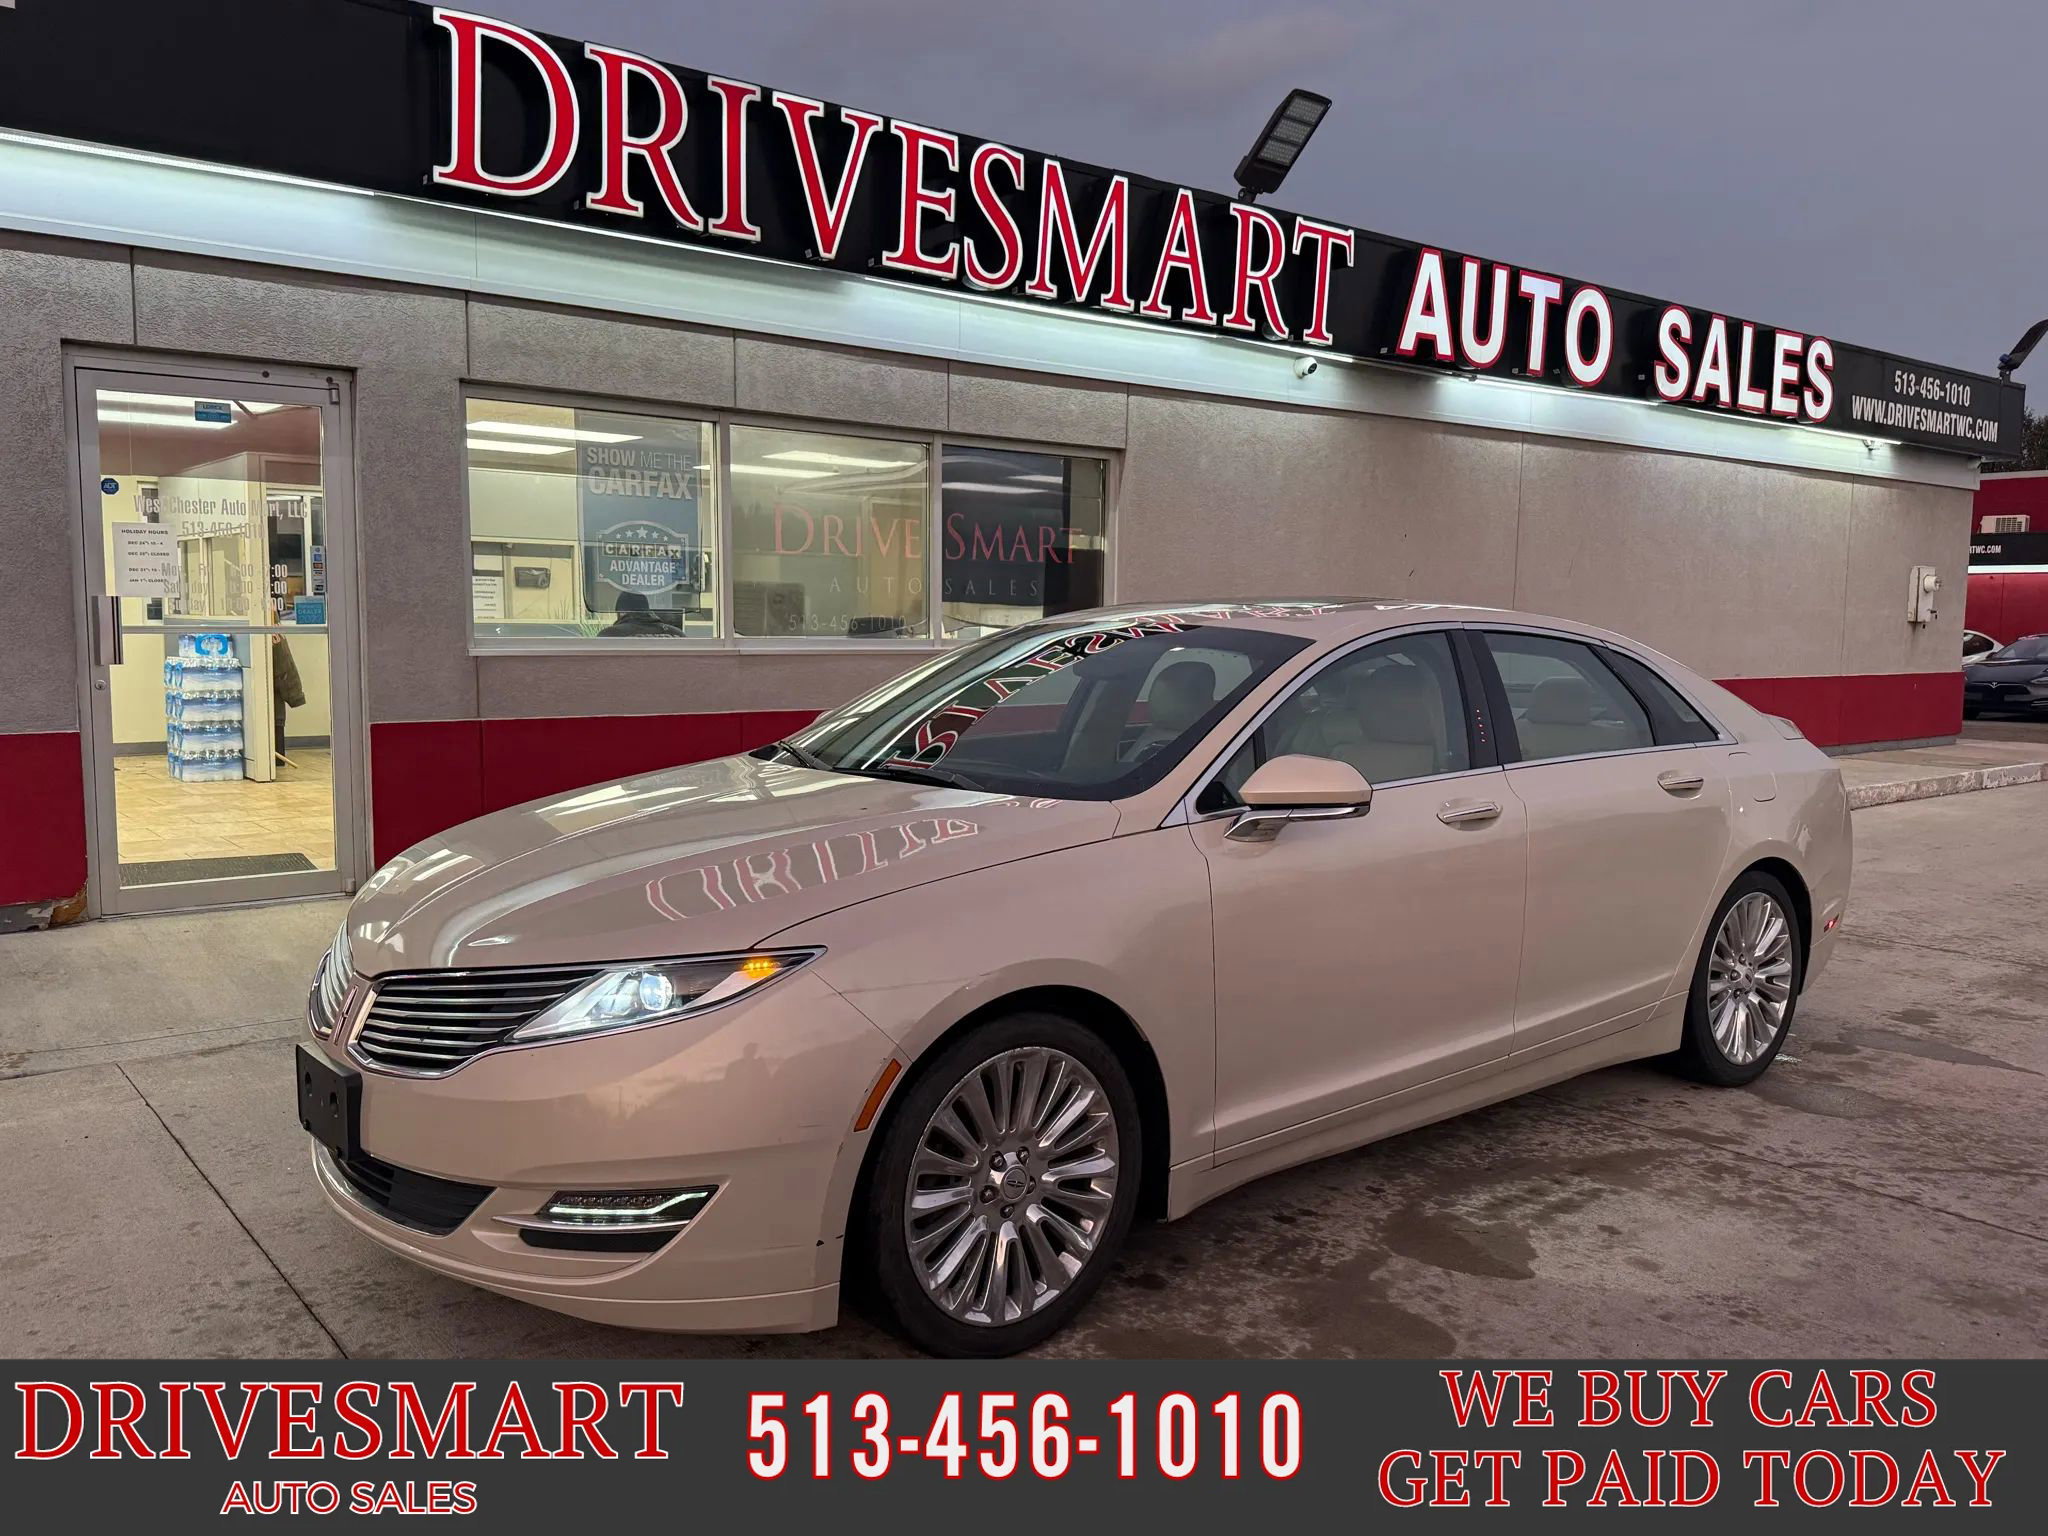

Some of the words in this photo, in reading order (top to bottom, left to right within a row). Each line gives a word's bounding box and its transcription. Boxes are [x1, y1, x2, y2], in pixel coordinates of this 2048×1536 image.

[431, 6, 1356, 346] DRIVESMART
[1396, 247, 1614, 388] AUTO
[1654, 304, 1835, 423] SALES
[1894, 369, 1971, 408] 513-456-1010
[1852, 394, 1999, 443] WWW.DRIVESMARTWC.COM
[587, 447, 635, 467] SHOW
[640, 452, 662, 468] ME
[663, 453, 692, 471] THE
[588, 466, 695, 500] CARFAX
[170, 495, 216, 515] Chester
[221, 498, 247, 516] Auto
[251, 500, 284, 521] Mrt,
[287, 501, 308, 519] LLC
[772, 502, 922, 560] DRIVE
[945, 512, 1082, 565] SMART
[603, 543, 682, 559] CARFAX
[610, 560, 676, 573] ADVANTAGE
[163, 578, 207, 596] Satday
[622, 574, 665, 586] DEALER
[829, 576, 922, 594] AUTO
[944, 577, 1040, 598] SALES
[788, 613, 906, 632] 513-456-1010
